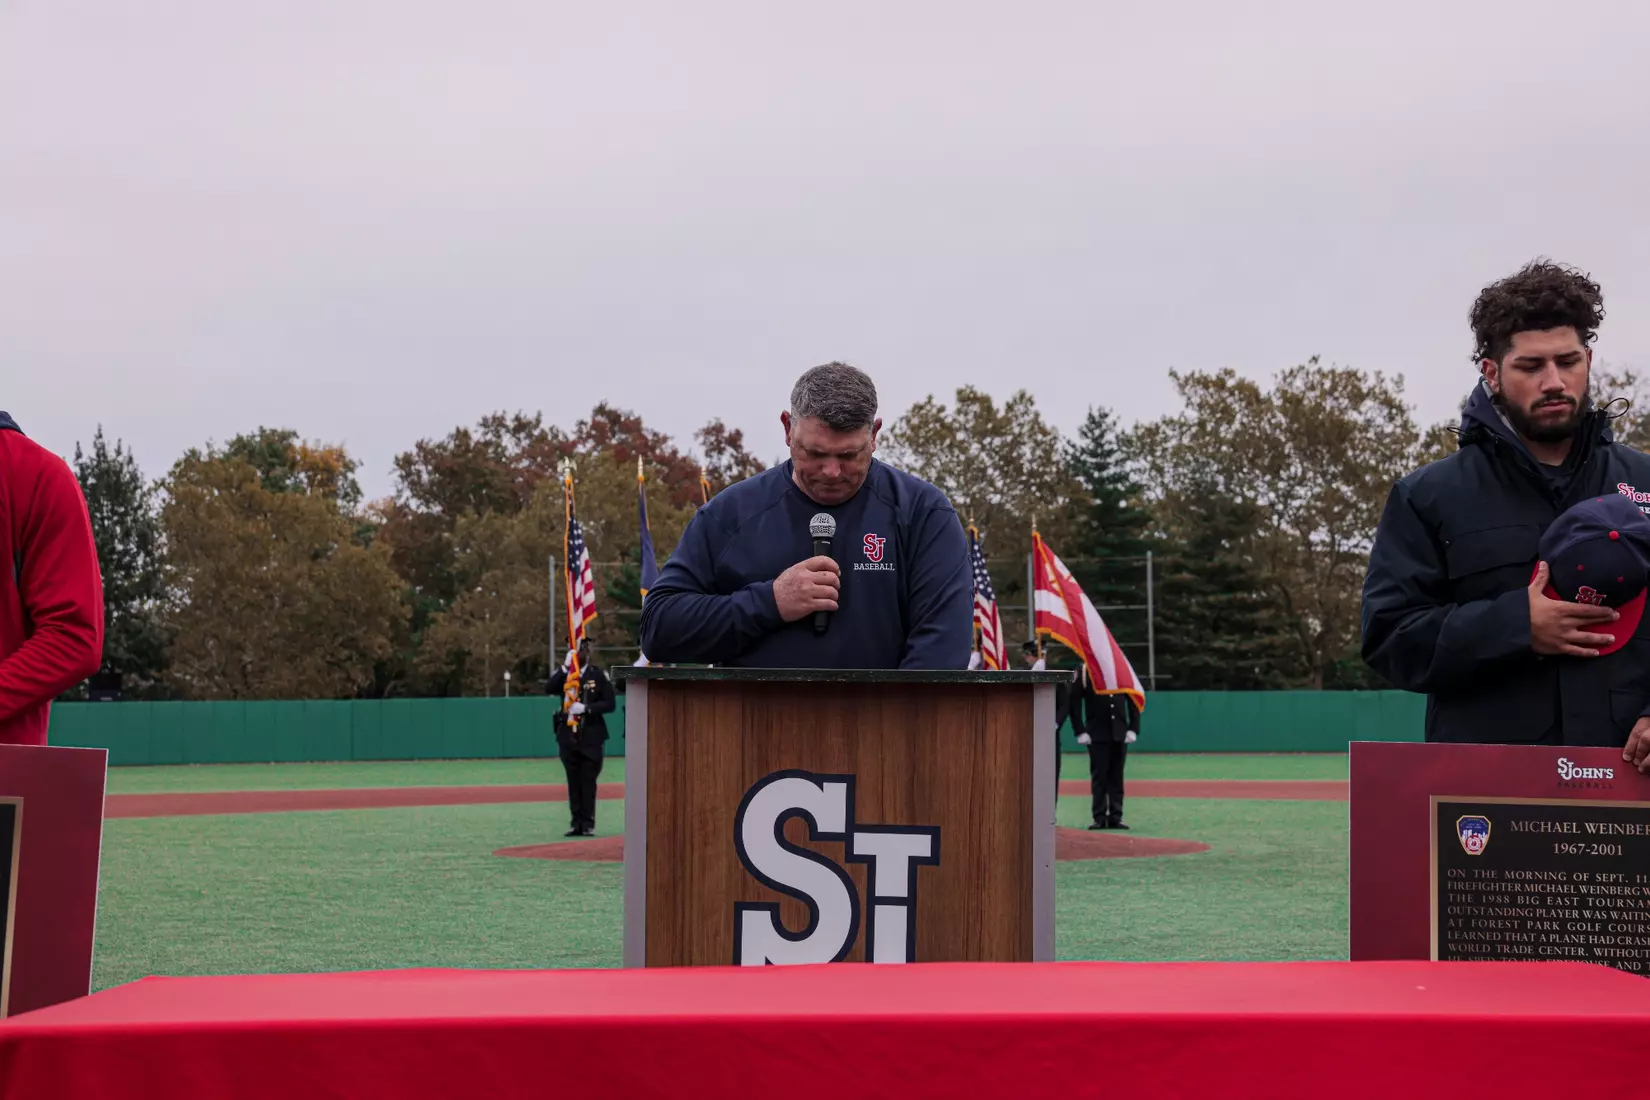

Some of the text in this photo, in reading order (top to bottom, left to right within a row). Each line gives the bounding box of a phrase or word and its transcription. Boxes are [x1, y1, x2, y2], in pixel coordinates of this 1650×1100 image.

[853, 563, 895, 571] BASEBALL
[1510, 820, 1581, 834] MICHAEL
[1553, 842, 1623, 856] 1967-2001
[1447, 868, 1466, 878] ON
[1472, 869, 1498, 879] THE
[1504, 870, 1567, 881] MORNING
[1573, 872, 1590, 881] OF
[1595, 873, 1629, 883] SEPT.
[1447, 881, 1522, 892] FIREFIGHTER
[1524, 883, 1577, 893] MICHAEL
[1579, 884, 1641, 896] WEINBERG
[1447, 893, 1474, 903] THE
[1482, 894, 1510, 904] 1988
[1517, 895, 1540, 905] BIG
[1547, 896, 1580, 906] EAST
[1447, 906, 1533, 917] OUTSTANDING
[1536, 908, 1580, 919] PLAYER
[1582, 909, 1607, 920] WAS
[1447, 918, 1464, 928] AT
[1471, 919, 1521, 929] FOREST
[1527, 920, 1561, 931] PARK
[1567, 922, 1602, 932] GOLF
[1447, 931, 1501, 941] LEARNED
[1504, 932, 1537, 942] THAT
[1539, 933, 1547, 942] A
[1549, 933, 1587, 944] PLANE
[1589, 935, 1614, 945] HAD
[1447, 943, 1650, 958] WORLD TRADE CENTER. WITHOUT
[1615, 961, 1641, 971] AND
